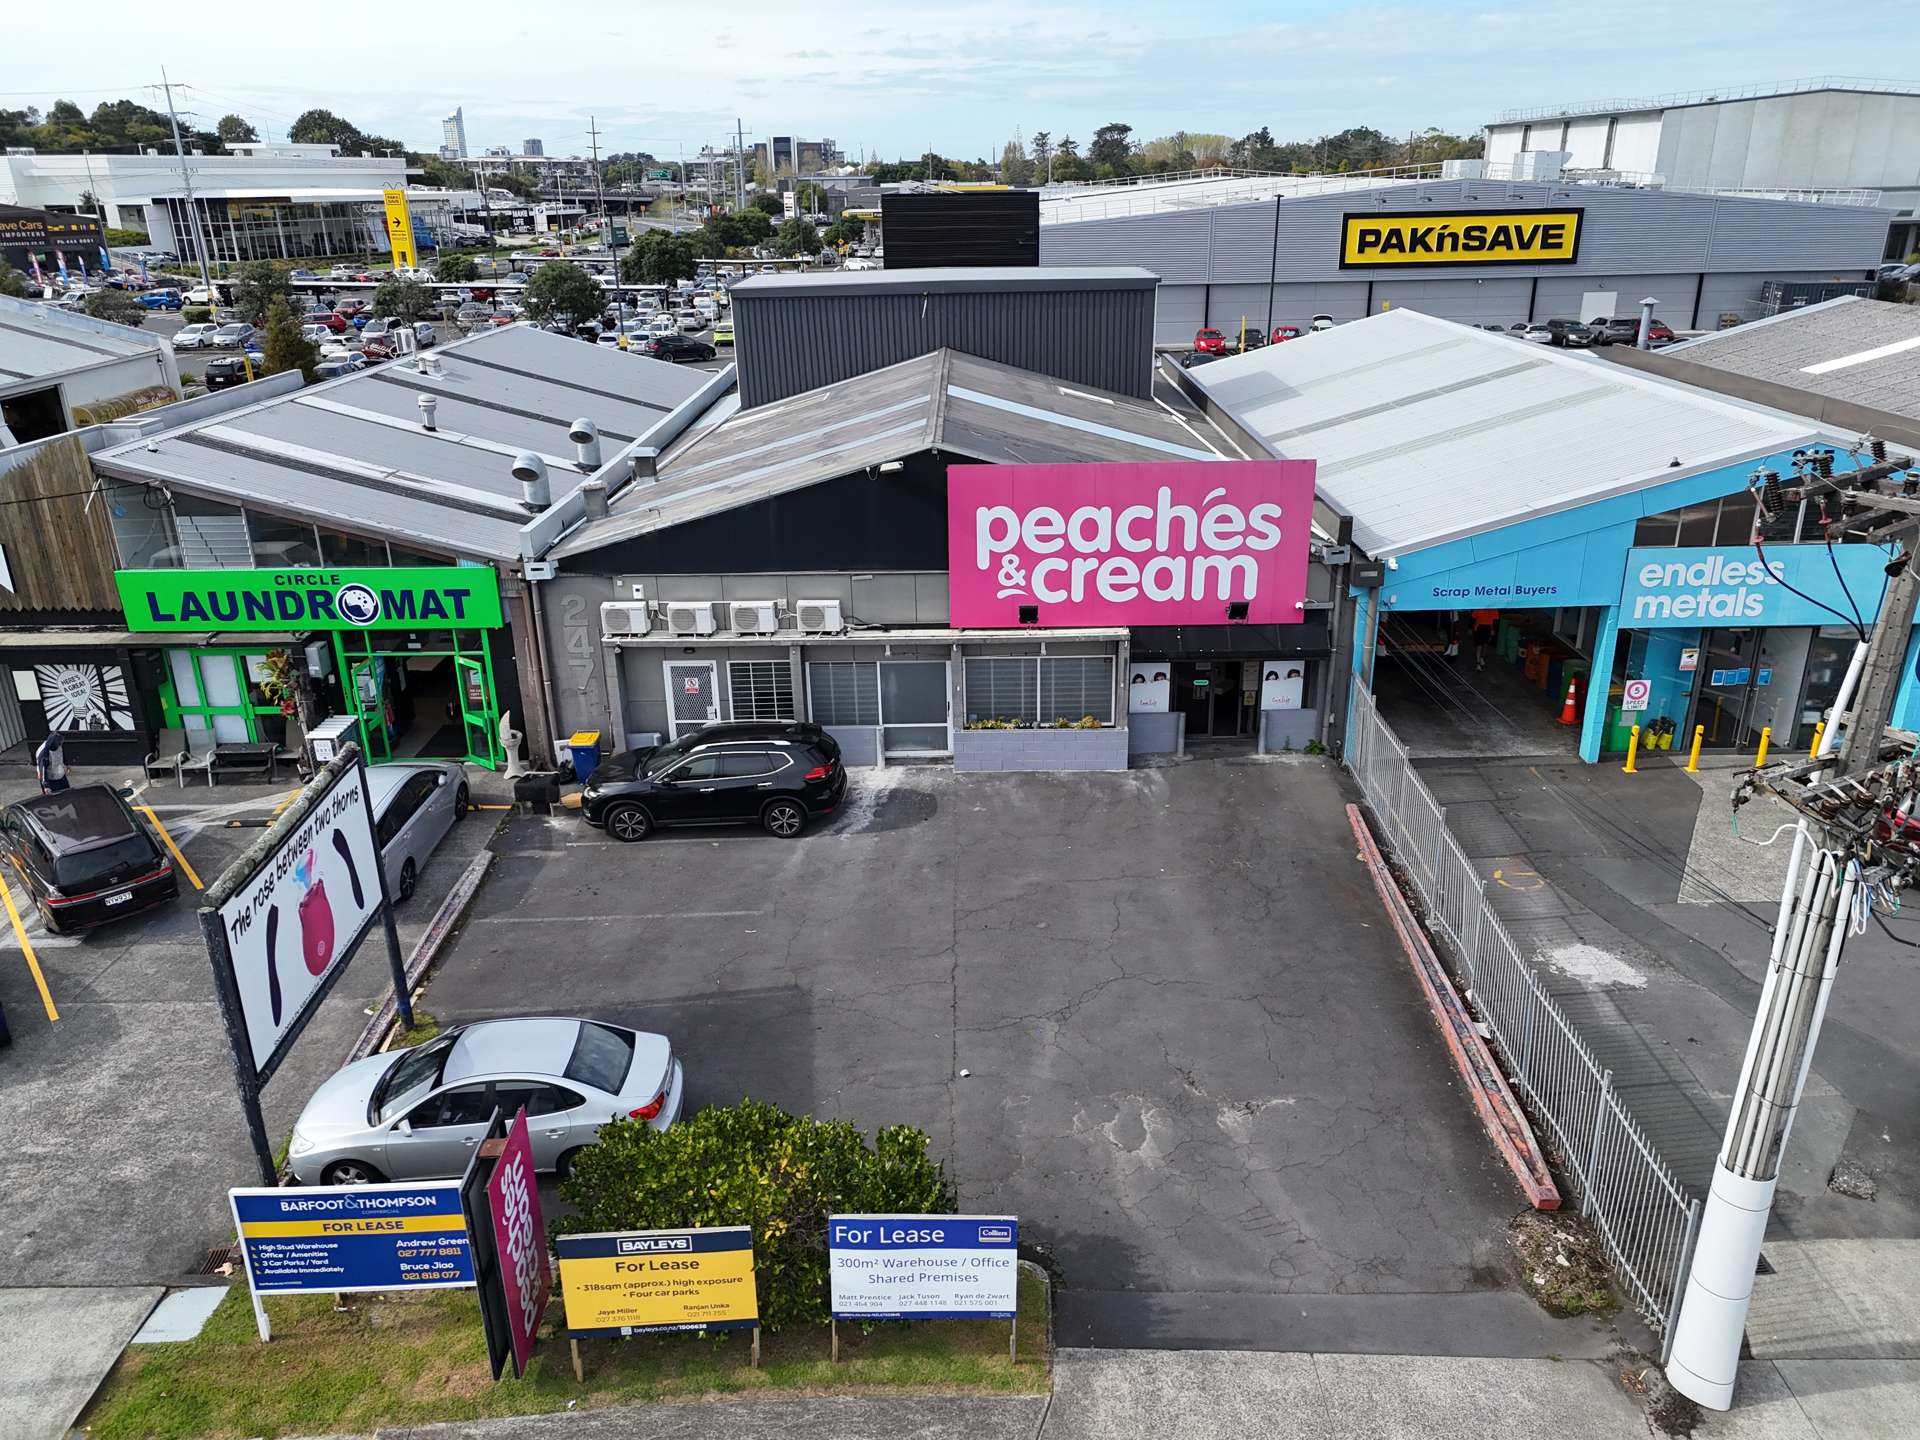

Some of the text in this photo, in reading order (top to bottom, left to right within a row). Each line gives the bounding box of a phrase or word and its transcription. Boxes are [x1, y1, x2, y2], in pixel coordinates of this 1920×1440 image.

[19, 220, 43, 230] Cars
[1639, 555, 1785, 588] endless
[273, 574, 342, 586] CIRCLE
[1031, 554, 1259, 603] cream
[1432, 585, 1558, 598] Scrap Metal Buyers
[1633, 587, 1765, 619] metals
[560, 593, 596, 690] 247
[68, 681, 86, 691] GREAT
[1634, 686, 1641, 695] 5
[230, 784, 360, 945] The rose between two thorns
[512, 1150, 540, 1280] cream
[323, 1221, 405, 1232] FOR LEASE
[835, 1226, 1008, 1244] For Lease Colliers
[396, 1238, 470, 1248] Andrew Green
[622, 1239, 688, 1251] BAYLEYS
[398, 1249, 417, 1257] 027
[419, 1248, 437, 1256] 777
[400, 1263, 430, 1271] Bruce
[615, 1260, 700, 1273] For Lease
[882, 1257, 958, 1268] Warehouse
[970, 1257, 1010, 1268] Office
[299, 1266, 345, 1274] Immediately
[402, 1272, 420, 1280] 021
[441, 1271, 461, 1279] 077
[583, 1276, 744, 1292] 318sqm (approx.) high exposure
[868, 1272, 980, 1284] Shared Premises
[672, 1288, 700, 1297] parks
[954, 1293, 973, 1301] Ryan
